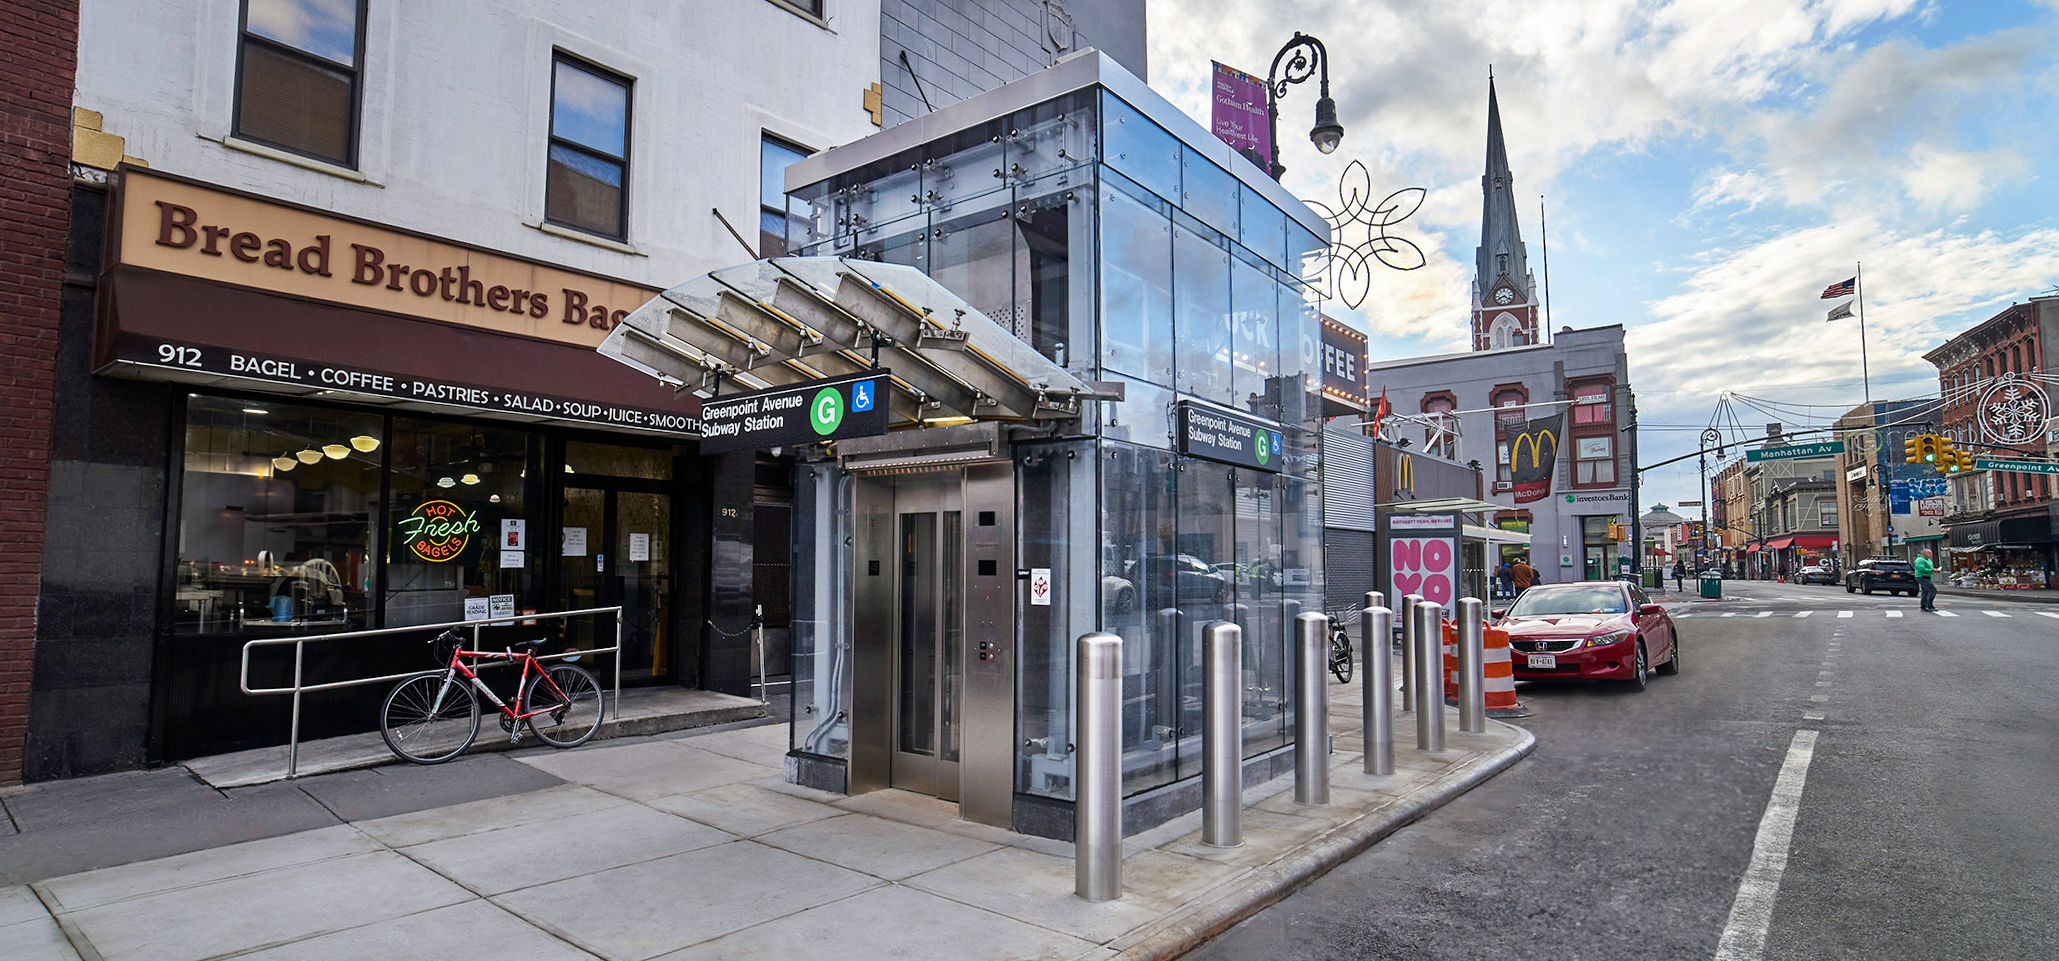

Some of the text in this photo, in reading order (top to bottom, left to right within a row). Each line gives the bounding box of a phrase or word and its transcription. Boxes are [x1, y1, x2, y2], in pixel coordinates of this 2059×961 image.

[1216, 95, 1265, 116] Gotham Health
[1216, 116, 1244, 131] Live Your
[1216, 126, 1247, 140] Healthiest
[155, 200, 631, 331] Bread Brothers Bag
[158, 343, 702, 431] 912 BAGEL COFFEE PASTRIES SALAD SOUP JUICE SMOOTH
[702, 394, 803, 421] Greenpoint Avenue
[817, 396, 836, 424] G
[701, 415, 784, 438] Subway Station
[1188, 409, 1251, 438] Greenpoint Avenue
[1188, 426, 1242, 451] Subway Station
[1257, 436, 1267, 457] G
[1760, 445, 1832, 458] Manhattan Av
[1988, 462, 2042, 471] Greenpoint
[1514, 488, 1546, 498] McDona
[426, 505, 456, 517] HOT
[722, 508, 736, 518] 912
[398, 510, 481, 545] Fresh
[416, 537, 462, 558] BAGELS
[1393, 540, 1451, 573] NO
[1393, 573, 1451, 606] YO
